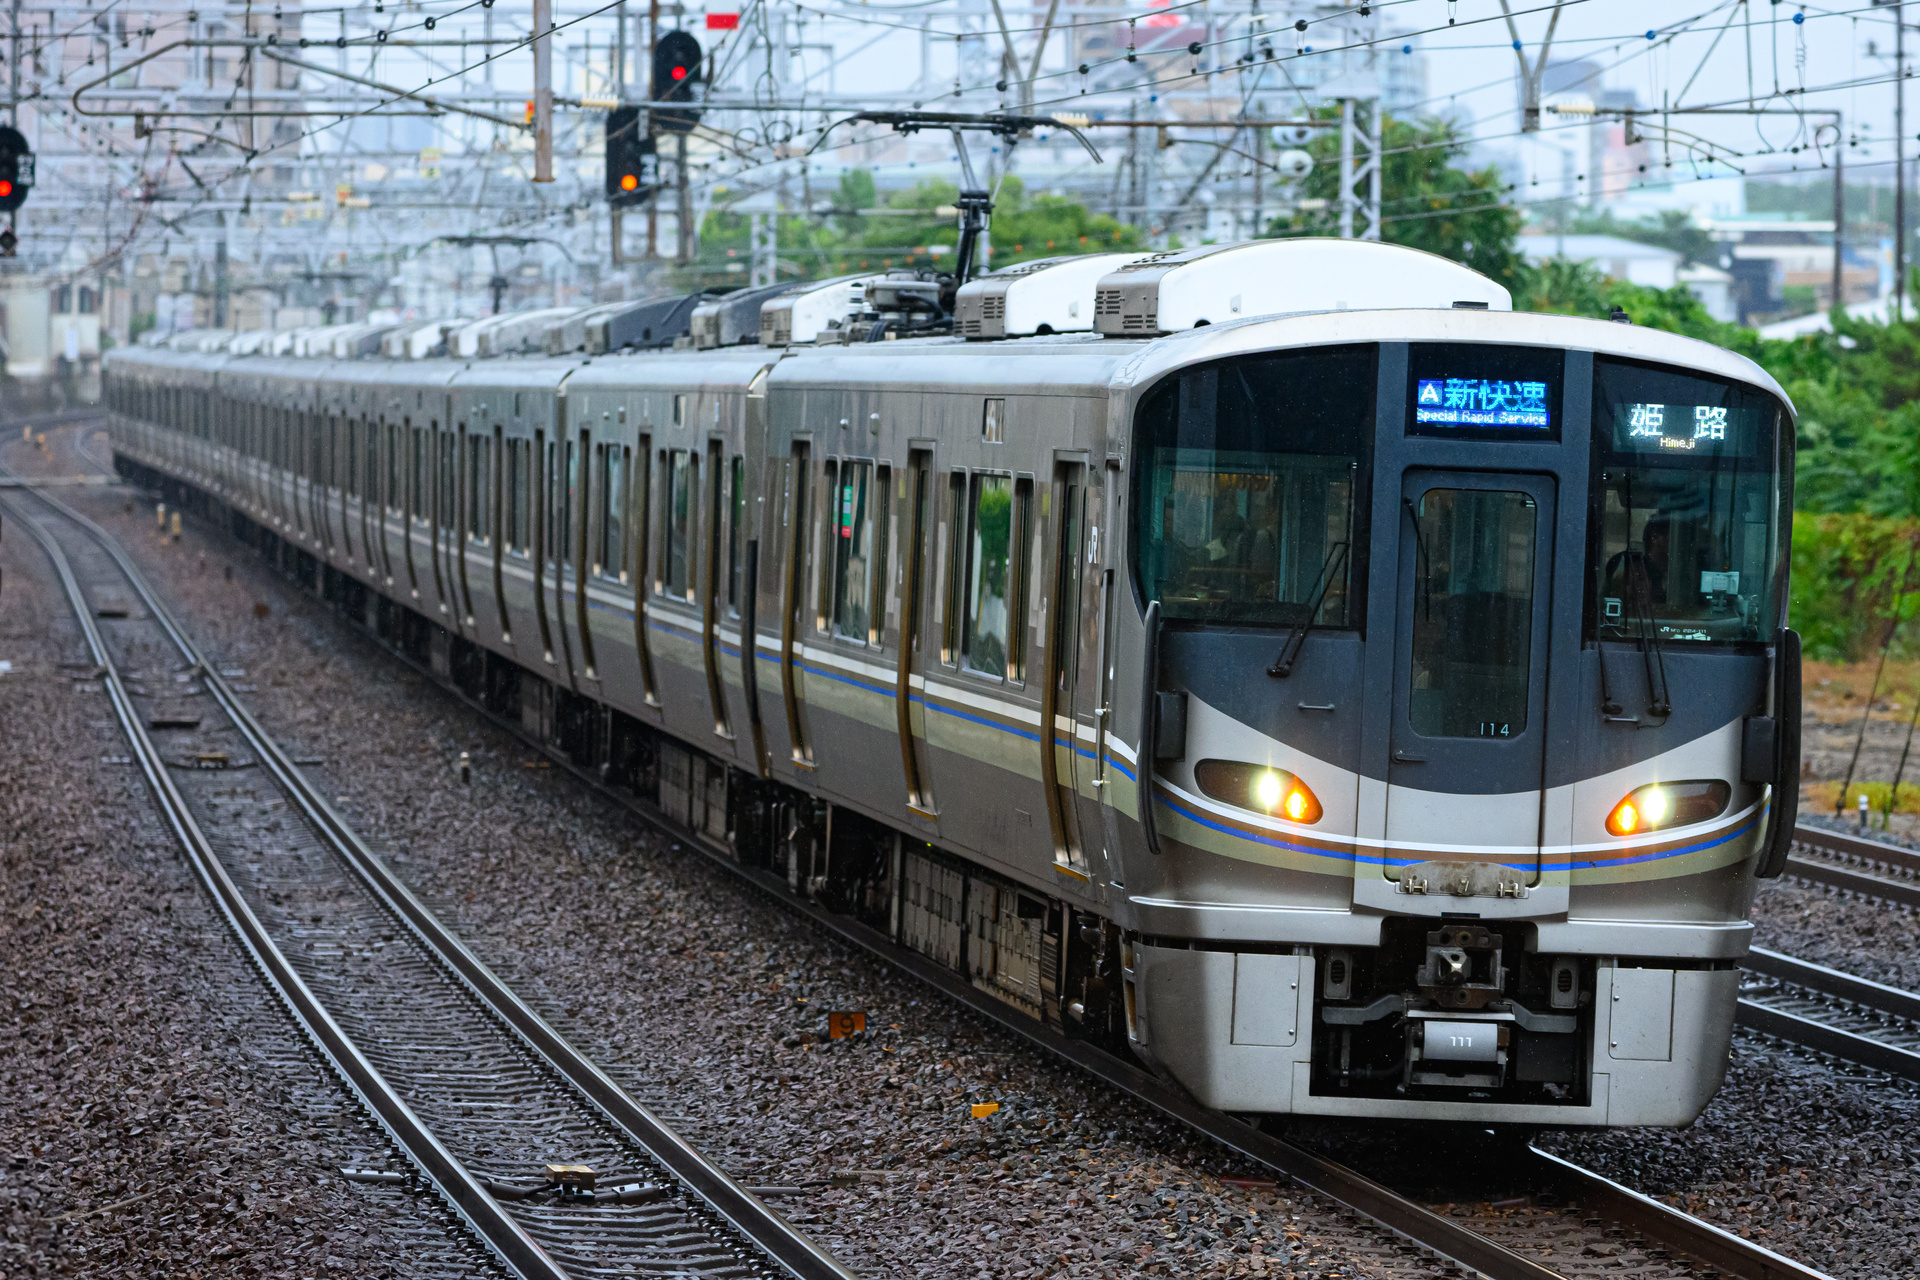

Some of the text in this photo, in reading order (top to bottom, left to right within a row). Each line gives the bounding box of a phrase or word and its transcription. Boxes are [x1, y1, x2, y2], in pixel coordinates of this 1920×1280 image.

[1420, 378, 1546, 412] A 新快速
[1417, 408, 1547, 425] Special Rapid Service
[1660, 438, 1695, 449] Himeji
[1087, 526, 1098, 564] JR
[840, 1015, 855, 1036] 9
